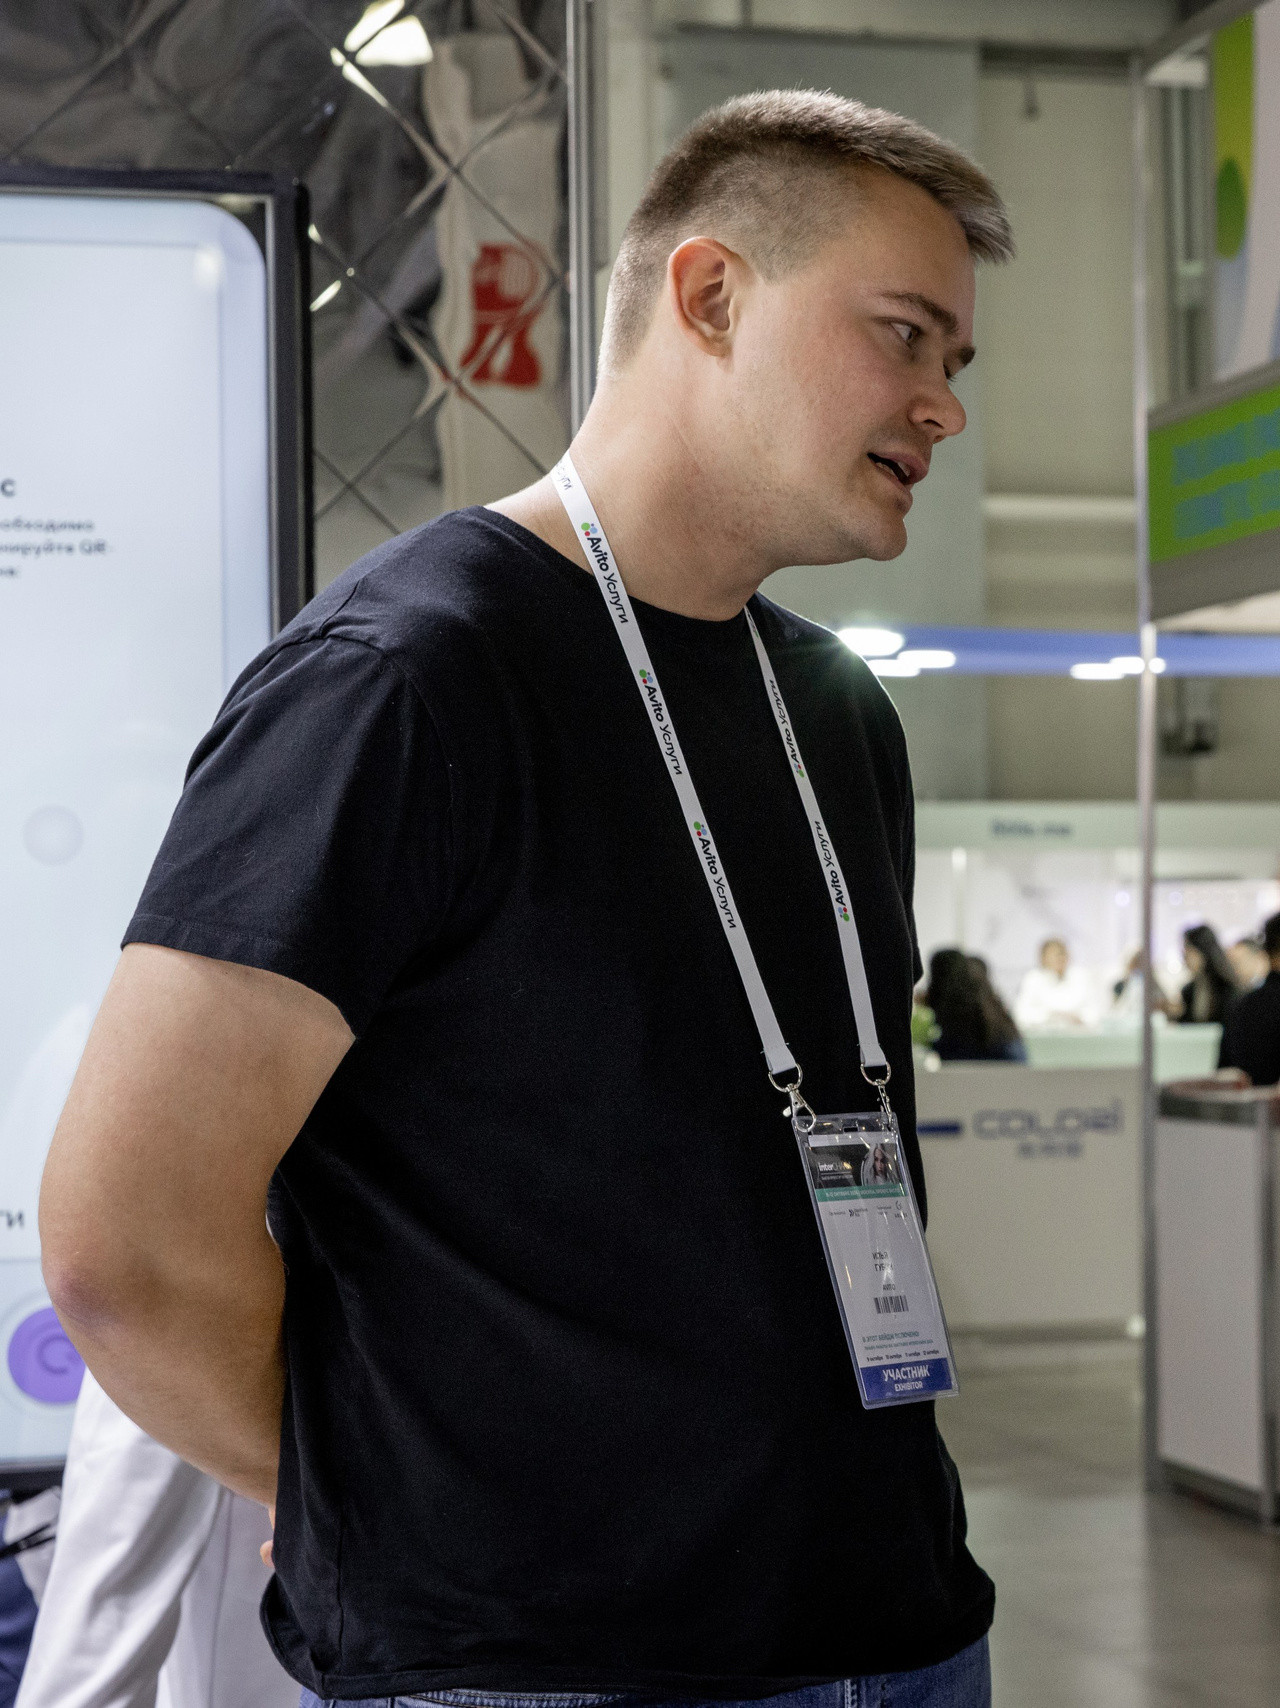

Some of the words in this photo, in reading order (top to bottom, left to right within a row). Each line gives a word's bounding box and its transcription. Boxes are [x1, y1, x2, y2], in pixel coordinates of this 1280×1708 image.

[587, 537, 609, 572] Avito
[603, 573, 629, 623] Услуги
[770, 680, 788, 726] Услуги
[645, 684, 664, 722] Avito
[660, 724, 683, 775] Услуги
[785, 728, 799, 763] Avito
[814, 820, 834, 867] Услуги
[699, 837, 718, 875] Avito
[713, 877, 737, 928] Услуги
[830, 869, 846, 907] Avito
[882, 1365, 930, 1381] УЧАСТНИК
[894, 1381, 923, 1392] EXHIBITOR
